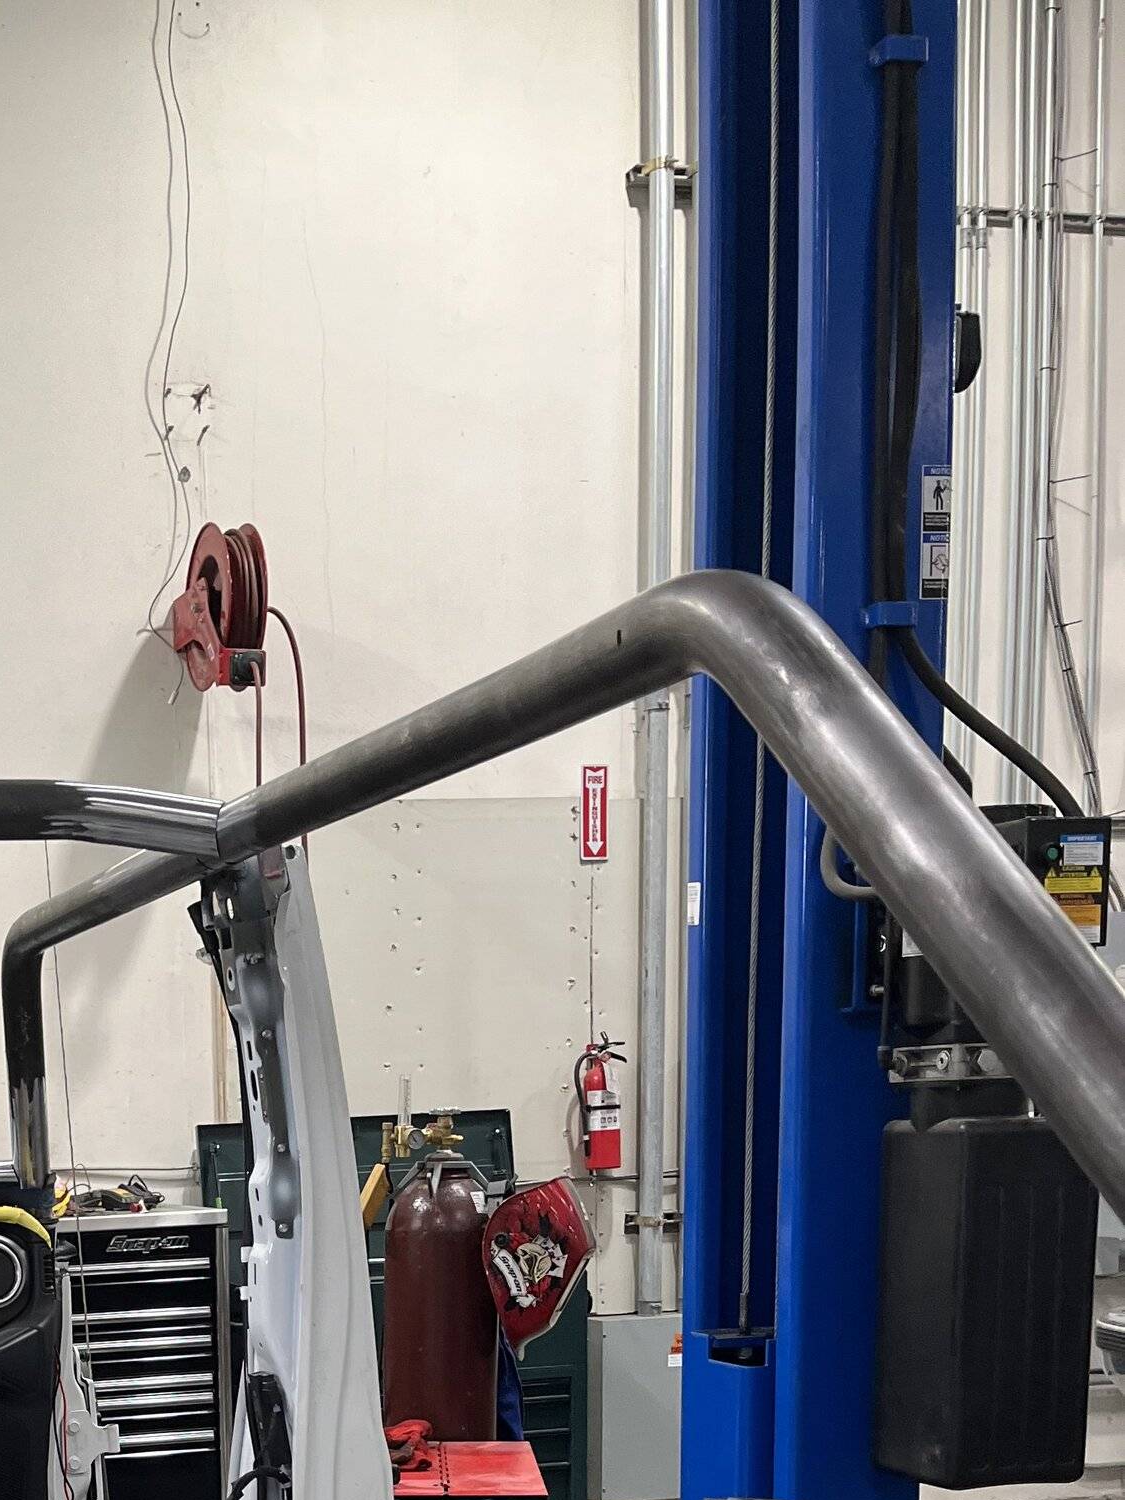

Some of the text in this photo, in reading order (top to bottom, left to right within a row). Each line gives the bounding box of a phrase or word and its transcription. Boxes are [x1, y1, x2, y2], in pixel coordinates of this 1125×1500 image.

[587, 775, 603, 785] FIRE
[106, 1235, 190, 1254] Snap-on
[499, 1255, 523, 1293] Snap-on
